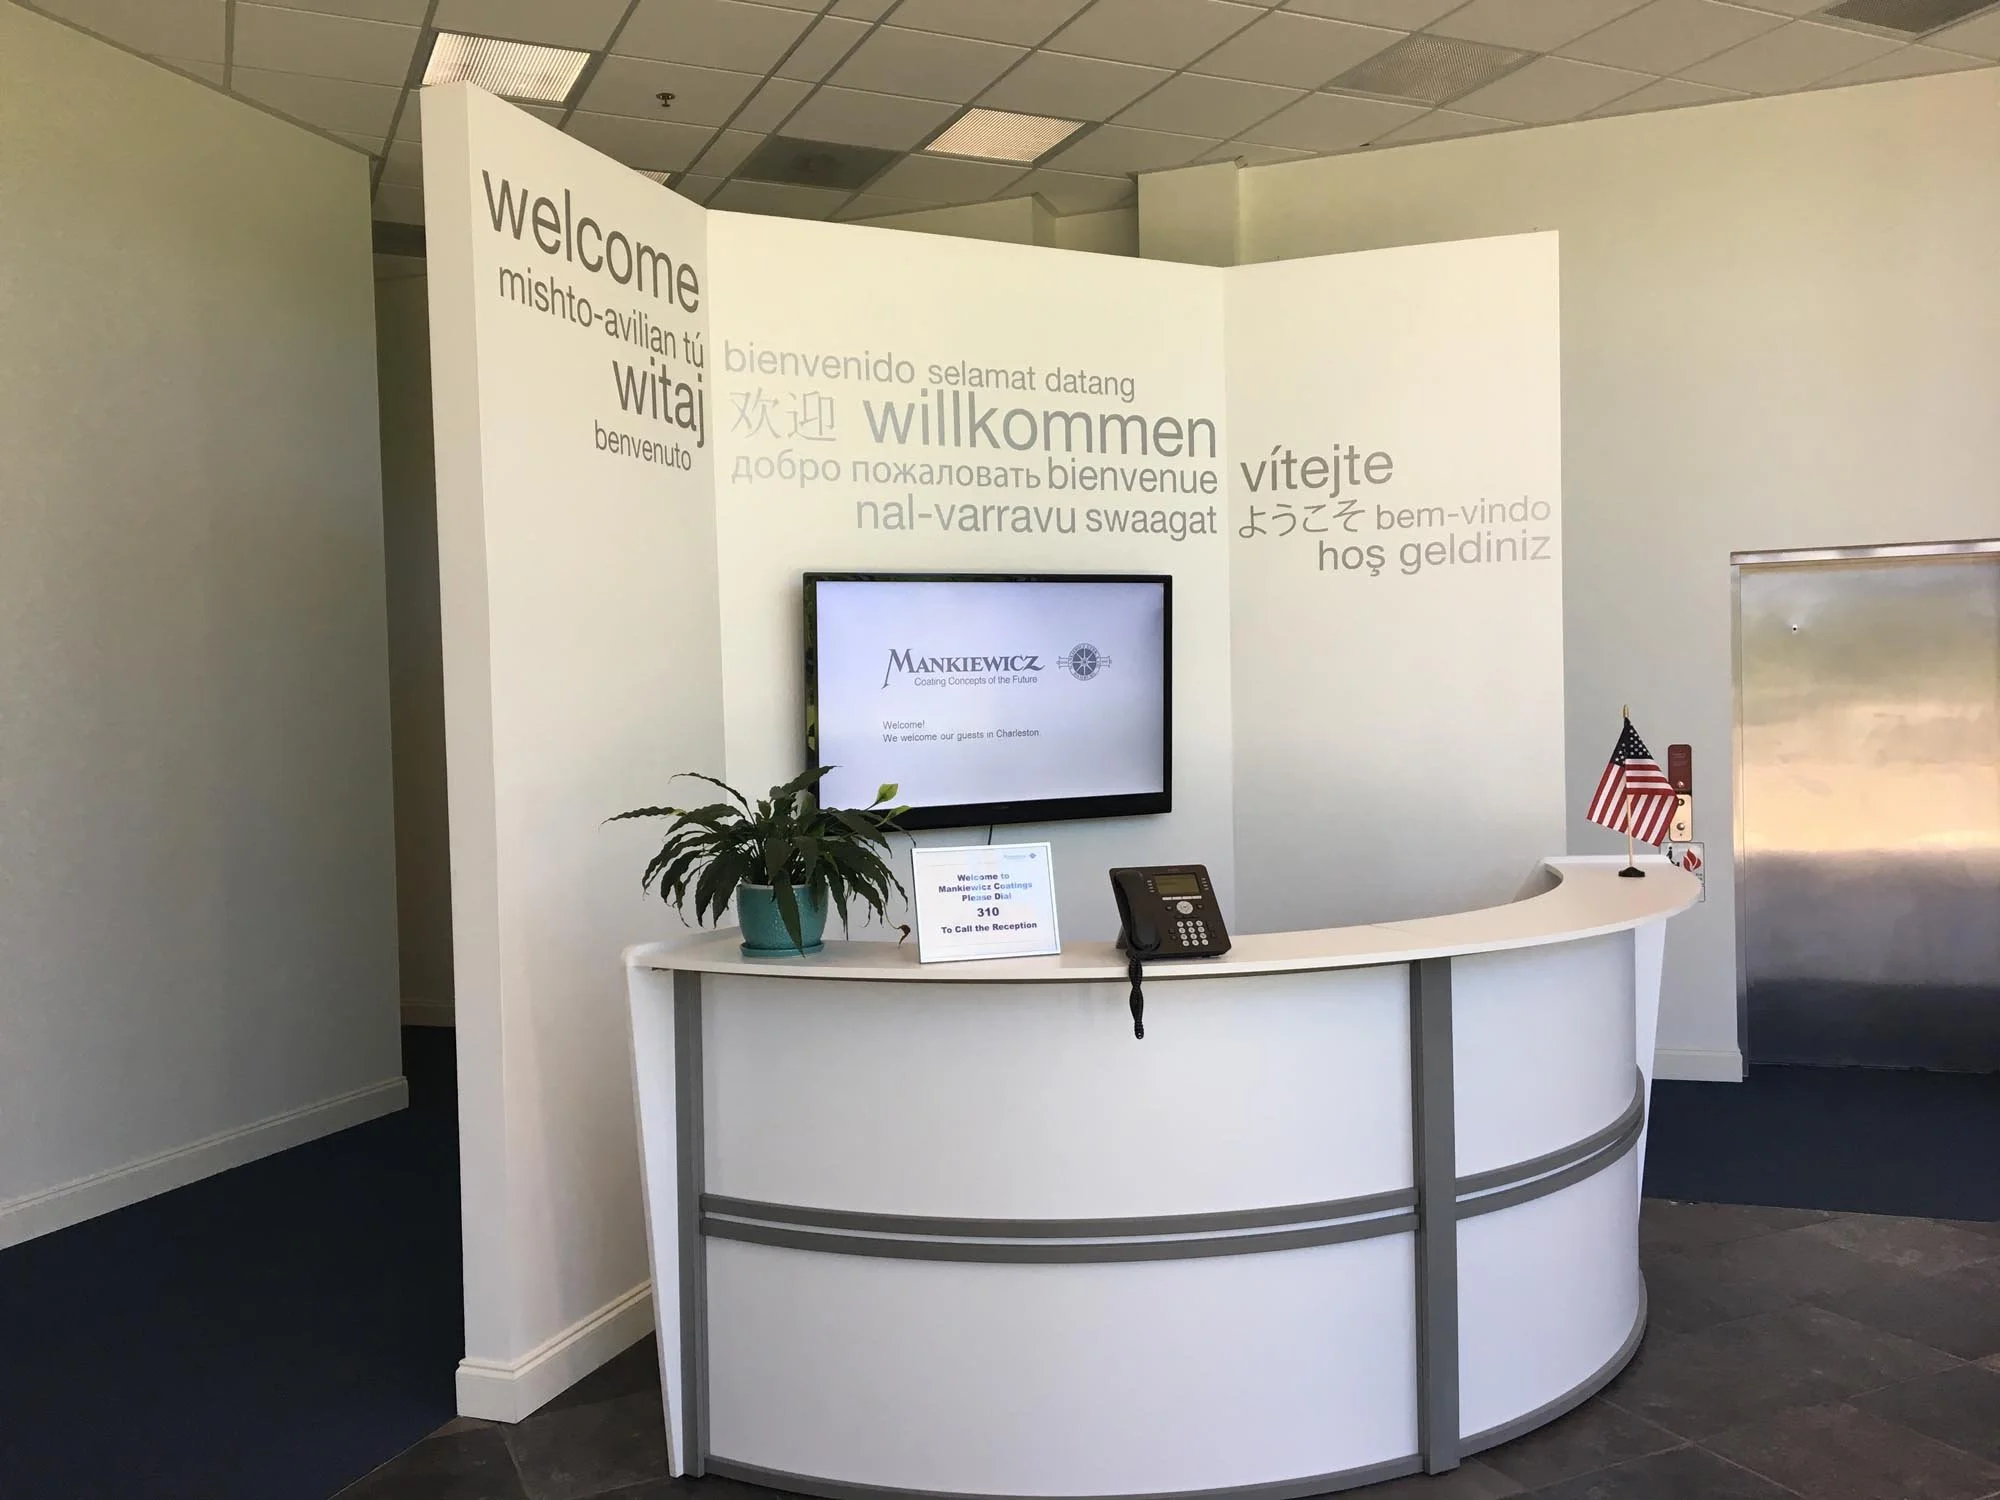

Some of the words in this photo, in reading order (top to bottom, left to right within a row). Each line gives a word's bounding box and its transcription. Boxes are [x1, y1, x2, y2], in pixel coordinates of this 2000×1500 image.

[482, 169, 700, 313] welcome
[499, 266, 677, 359] mishto-avilian
[683, 331, 704, 369] tú
[724, 340, 916, 385] bienvenido
[928, 361, 1036, 391] selamat
[1046, 367, 1136, 402] datang
[612, 356, 704, 448] witaj
[729, 386, 837, 443] 欢迎
[863, 388, 1217, 458] willkommen
[595, 419, 692, 471] benvenuto
[731, 449, 841, 488] добро
[852, 461, 1041, 490] пожаловать
[1047, 458, 1218, 494] bienvenue
[1240, 444, 1393, 498] vítejte
[856, 494, 1076, 533] nal-varravu
[1086, 505, 1218, 541] swaagat
[1238, 499, 1366, 538] ようこそ
[1376, 495, 1551, 530] bem-vindo
[1319, 540, 1386, 576] hoş
[1400, 529, 1551, 575] geldiniz
[914, 676, 946, 688] Coating
[948, 676, 986, 687] Concepts
[988, 675, 996, 684] of
[998, 675, 1010, 684] the
[1012, 675, 1038, 684] Future
[882, 720, 925, 730] Welcome!
[882, 733, 898, 743] We
[900, 733, 937, 742] welcome
[940, 732, 954, 741] our
[957, 731, 984, 741] guests
[986, 730, 994, 739] in
[938, 885, 992, 893] Mankiewicz
[993, 882, 1033, 890] Coatings
[957, 874, 998, 882] Welcome
[962, 894, 992, 902] Please
[994, 893, 1012, 901] Dial
[941, 926, 952, 934] To
[955, 925, 973, 933] Call
[975, 924, 990, 932] the
[992, 922, 1037, 931] Reception
[977, 907, 1000, 917] 310
